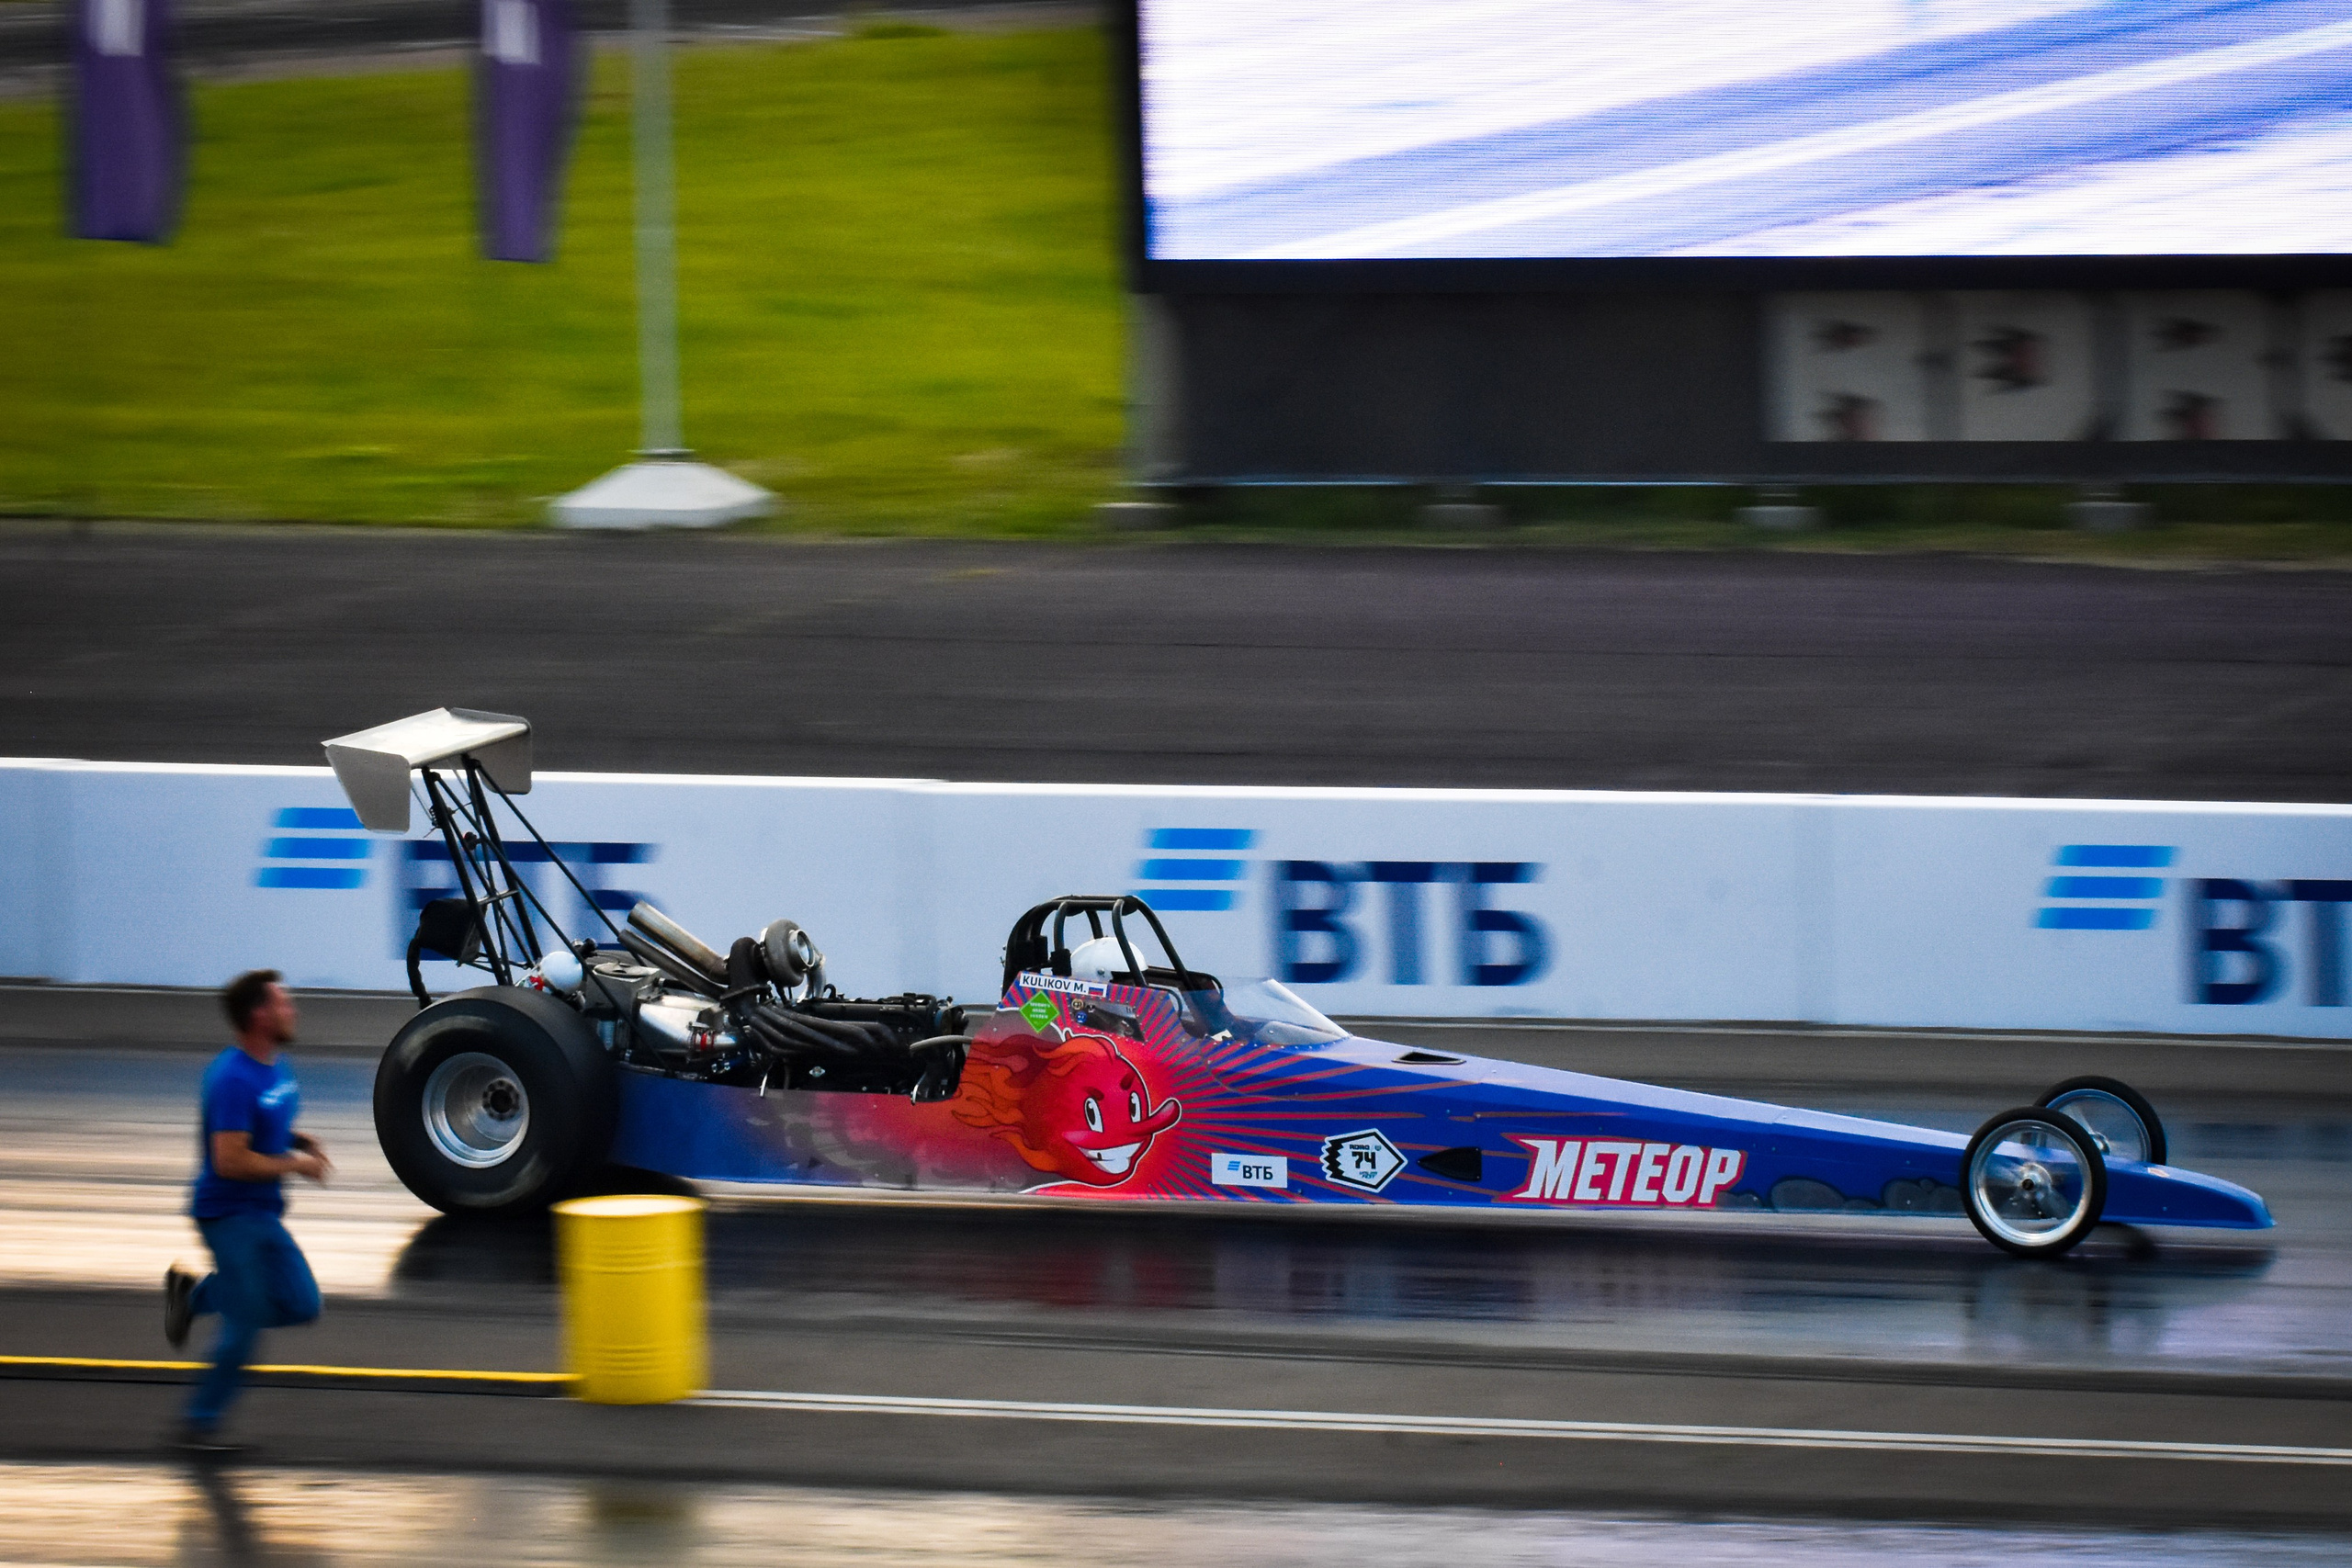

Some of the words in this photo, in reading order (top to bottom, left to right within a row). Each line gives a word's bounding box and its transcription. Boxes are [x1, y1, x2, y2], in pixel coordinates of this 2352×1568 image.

[1265, 860, 1555, 986] ВТБ
[1022, 975, 1071, 992] KULIKOV
[1073, 983, 1087, 993] M.
[1351, 1151, 1376, 1169] 74
[1242, 1165, 1273, 1180] ВТБ
